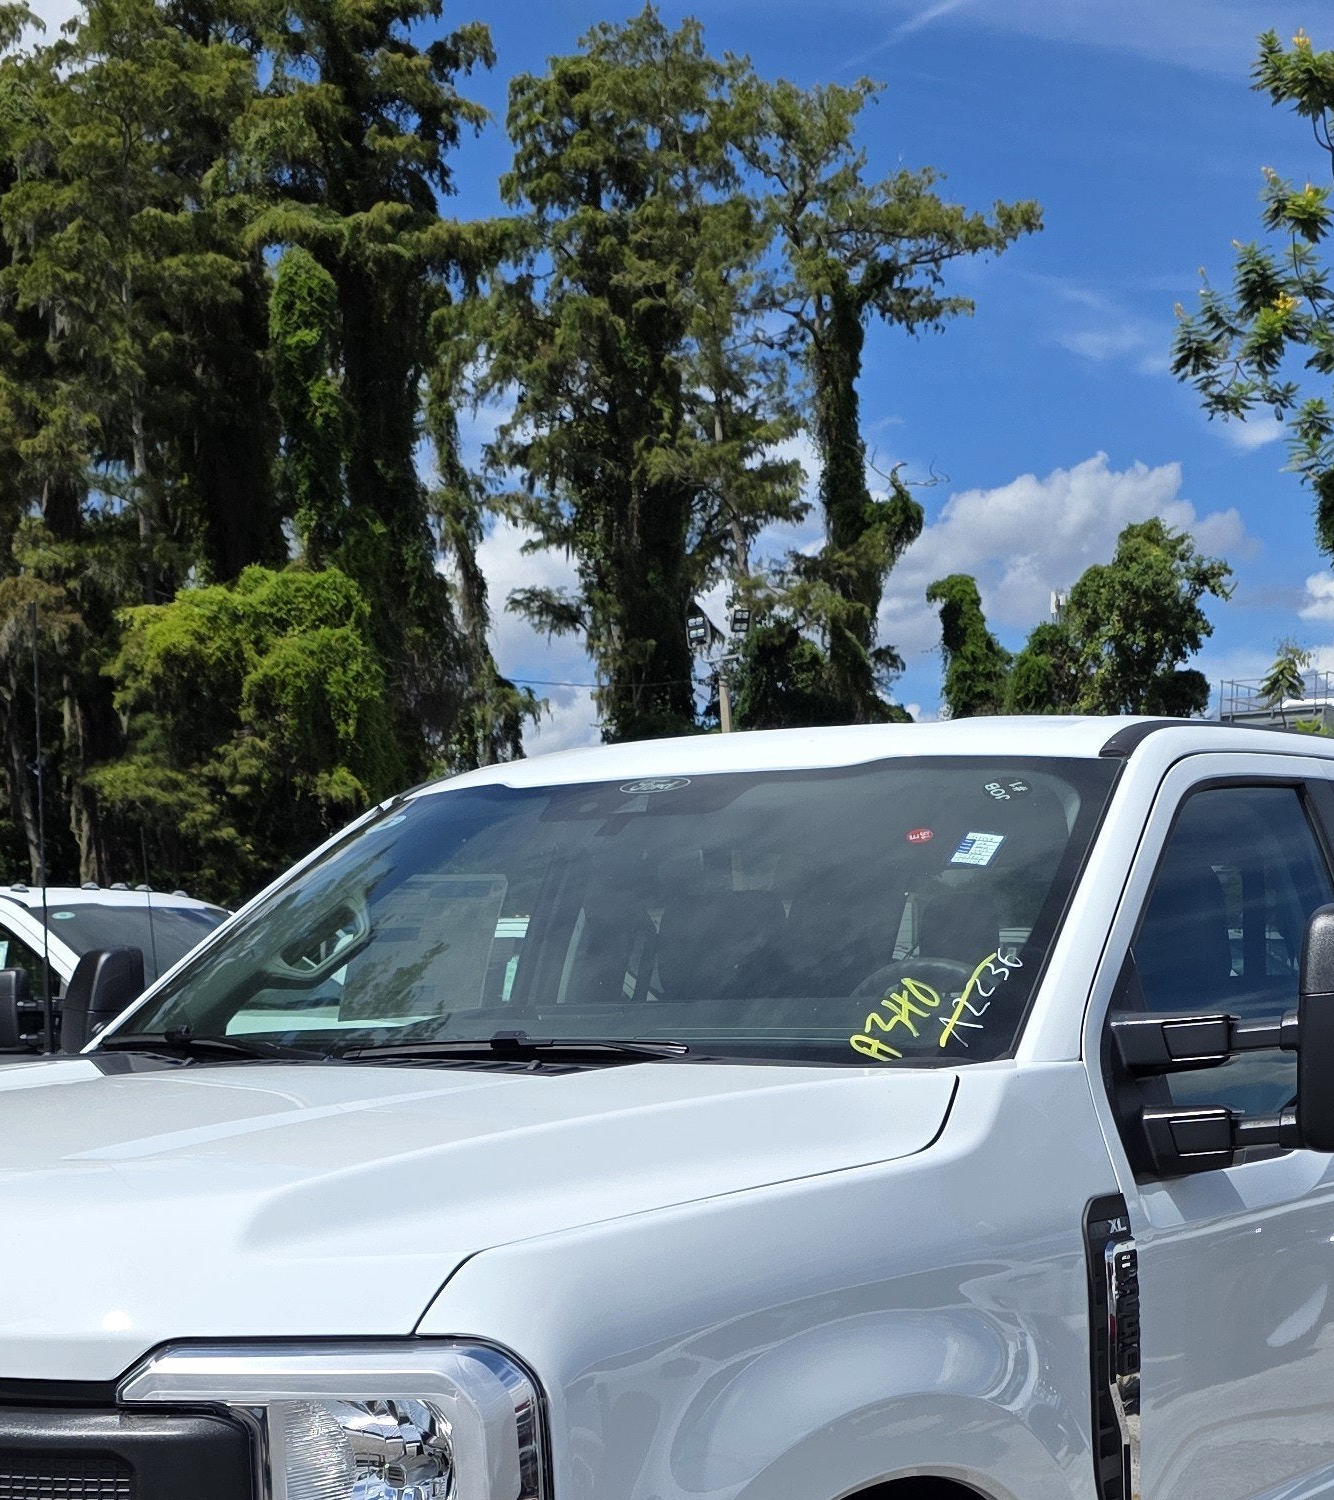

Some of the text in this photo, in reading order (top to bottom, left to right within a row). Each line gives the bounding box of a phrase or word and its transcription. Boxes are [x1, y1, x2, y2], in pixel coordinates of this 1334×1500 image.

[629, 778, 680, 793] Ford
[984, 782, 1011, 800] JOB
[1107, 1217, 1127, 1234] XL
